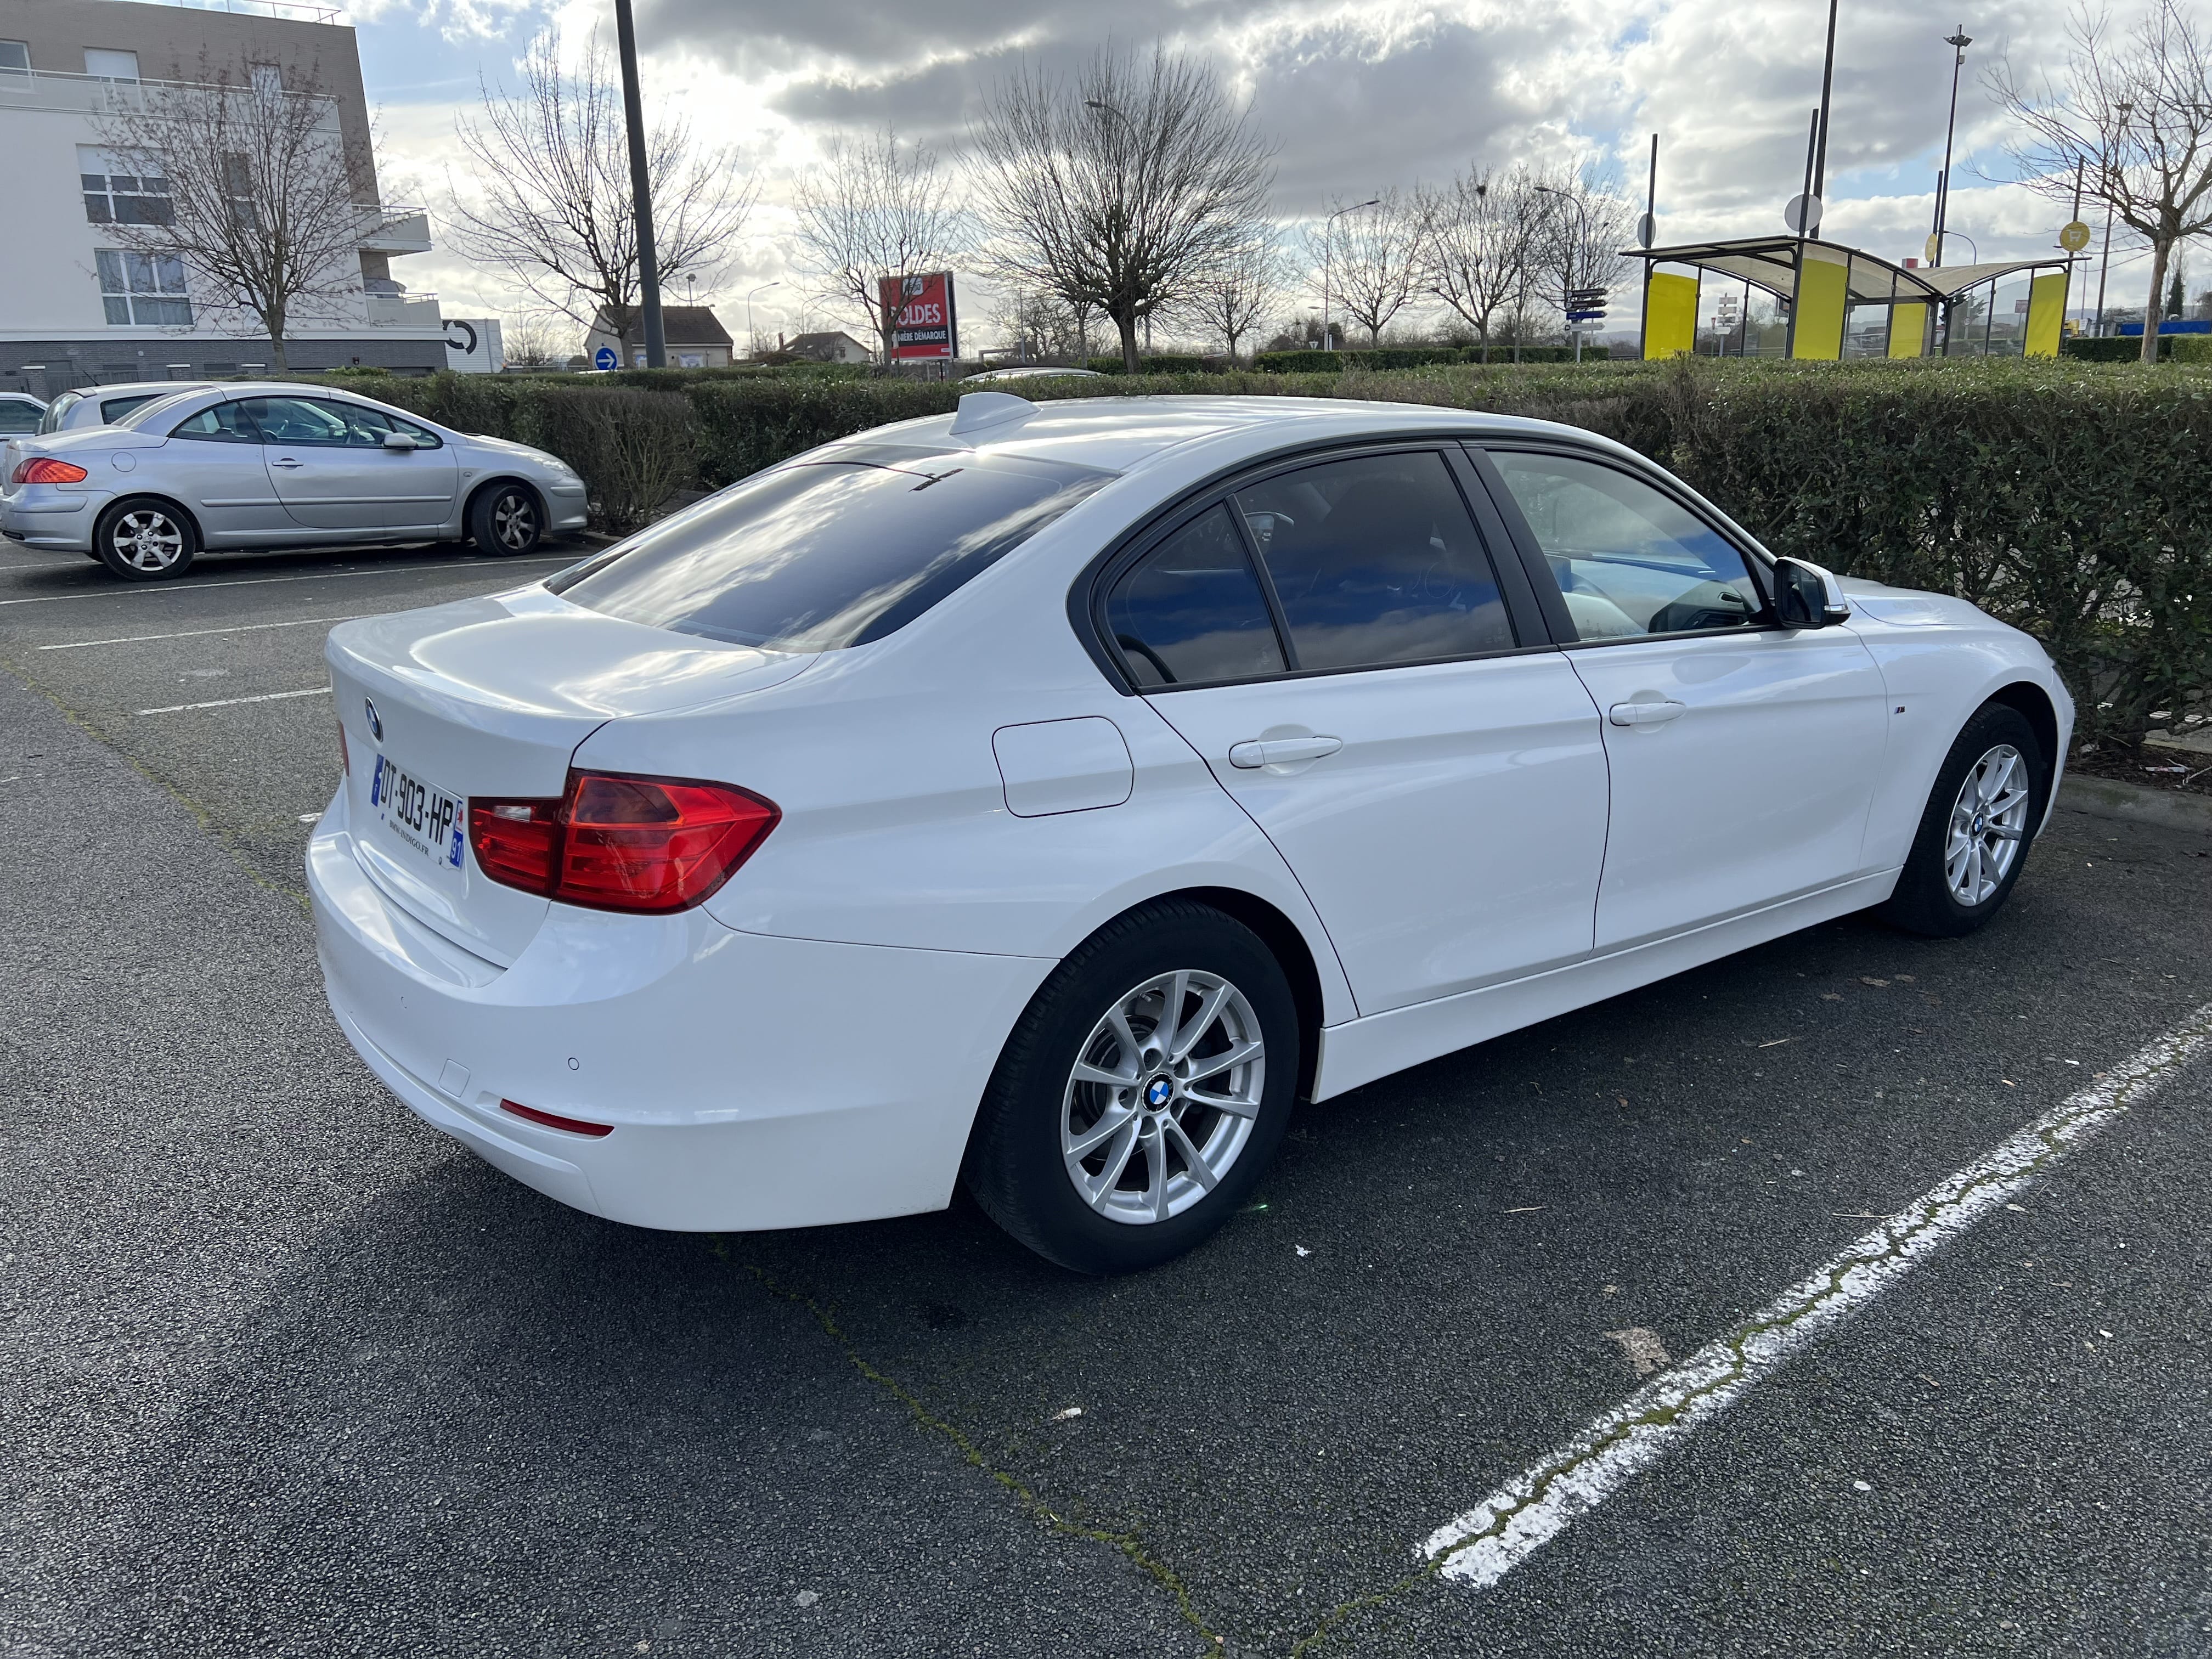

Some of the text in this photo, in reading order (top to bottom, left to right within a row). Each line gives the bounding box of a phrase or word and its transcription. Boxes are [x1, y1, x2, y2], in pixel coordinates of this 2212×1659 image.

[914, 329, 946, 341] DÉMARQUE
[380, 759, 454, 845] DT-903-HP
[389, 820, 430, 856] BMW-INDIGO.FR
[451, 838, 461, 862] 91
